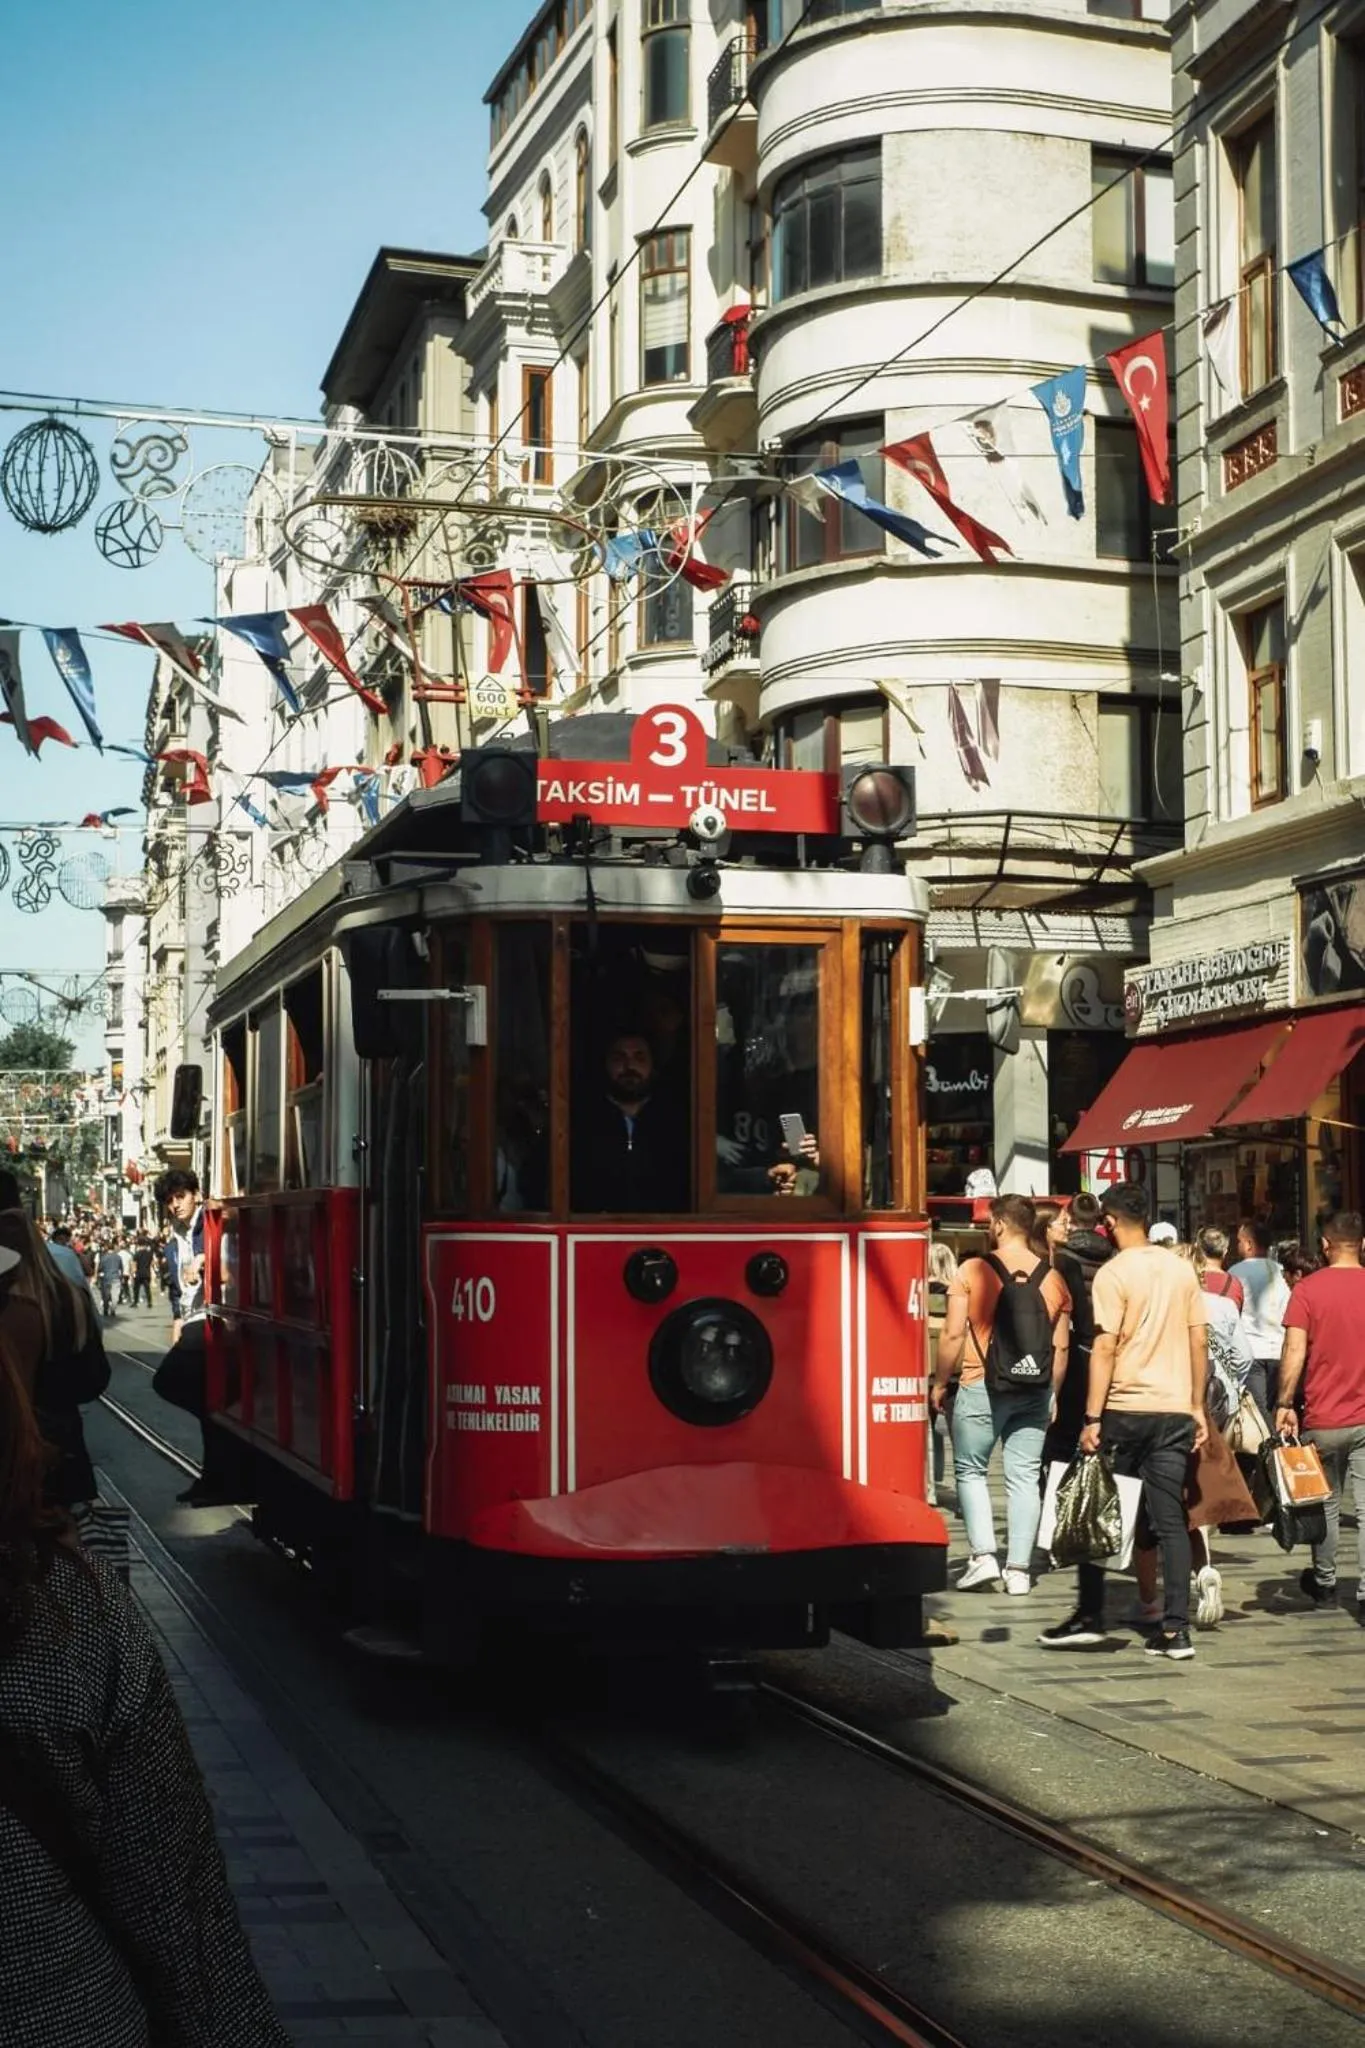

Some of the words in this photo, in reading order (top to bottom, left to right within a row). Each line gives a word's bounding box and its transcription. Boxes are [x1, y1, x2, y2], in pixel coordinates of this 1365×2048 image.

[476, 691, 506, 704] 600
[474, 705, 510, 717] VOLT
[649, 711, 688, 767] 3
[680, 780, 777, 812] TÜNEL
[452, 1276, 496, 1322] 410
[494, 1385, 542, 1405] YASAK
